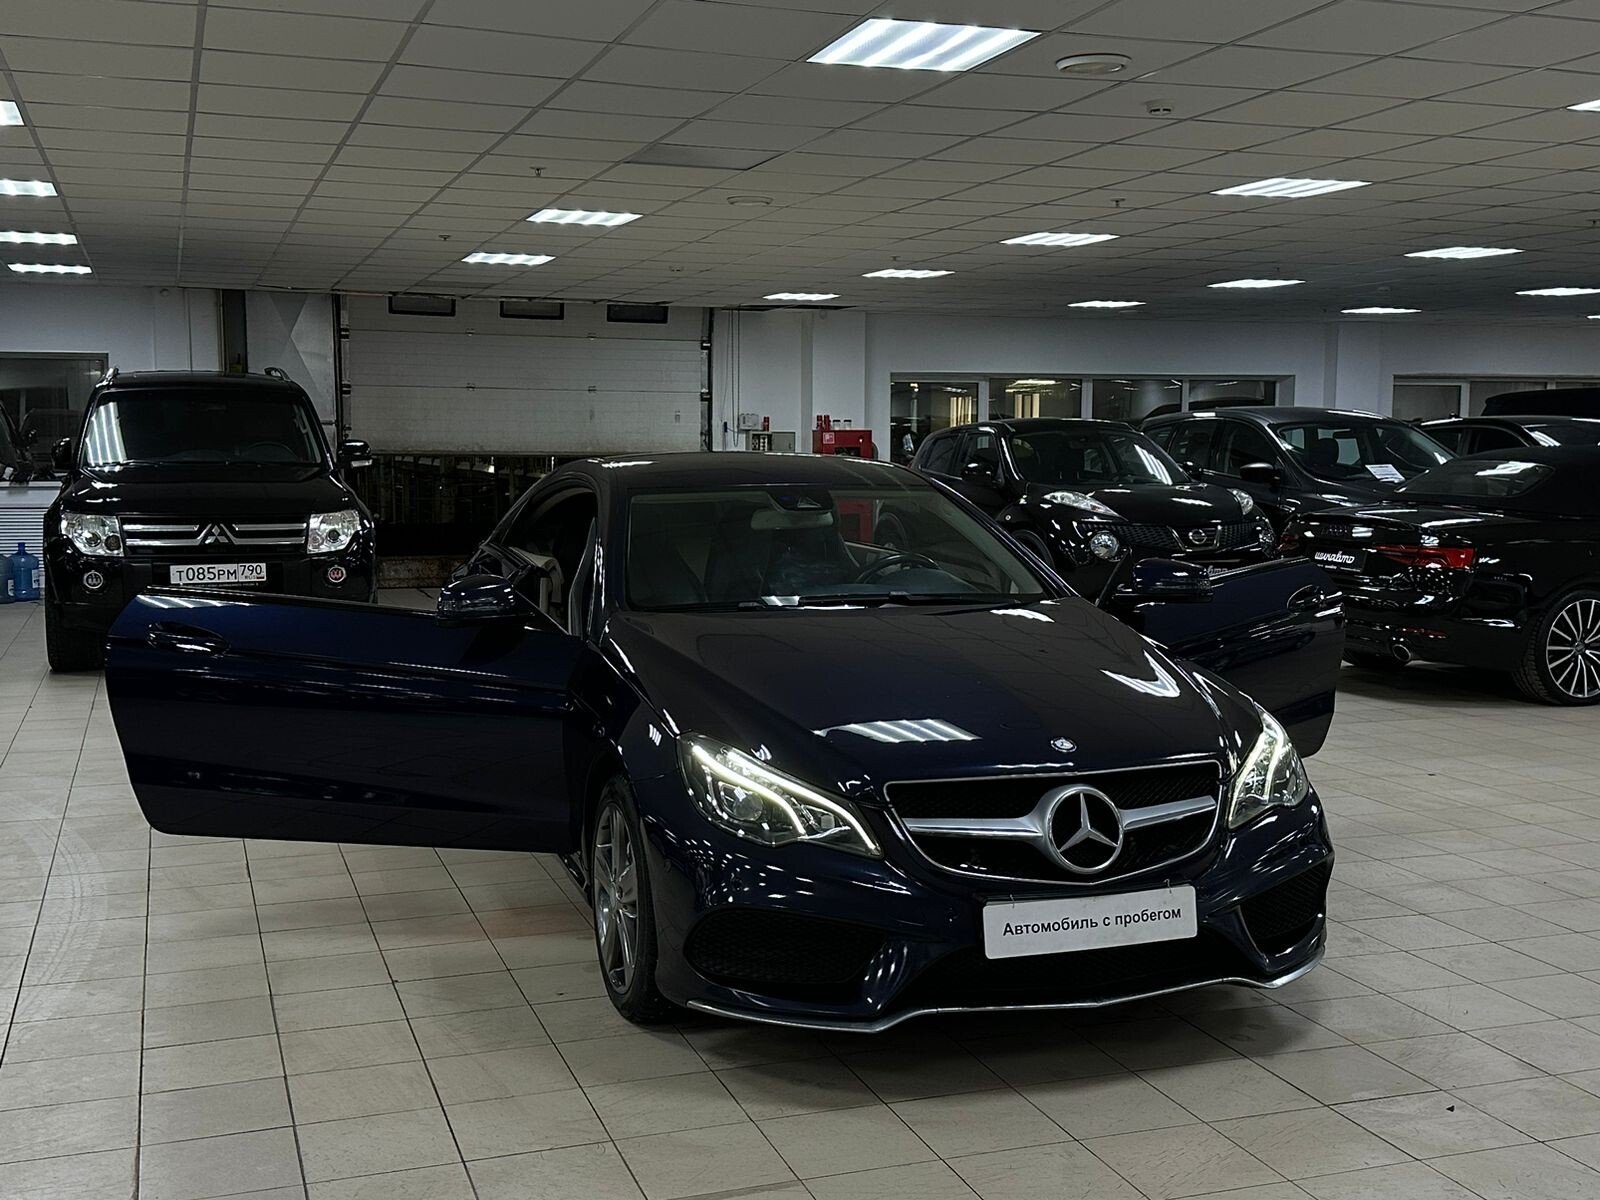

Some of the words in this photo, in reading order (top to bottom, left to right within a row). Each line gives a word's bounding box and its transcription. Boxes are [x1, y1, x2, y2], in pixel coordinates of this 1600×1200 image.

[241, 565, 262, 576] 790
[1002, 916, 1099, 936] Автомобиль
[1103, 912, 1111, 926] с
[1115, 908, 1182, 928] пробегом
